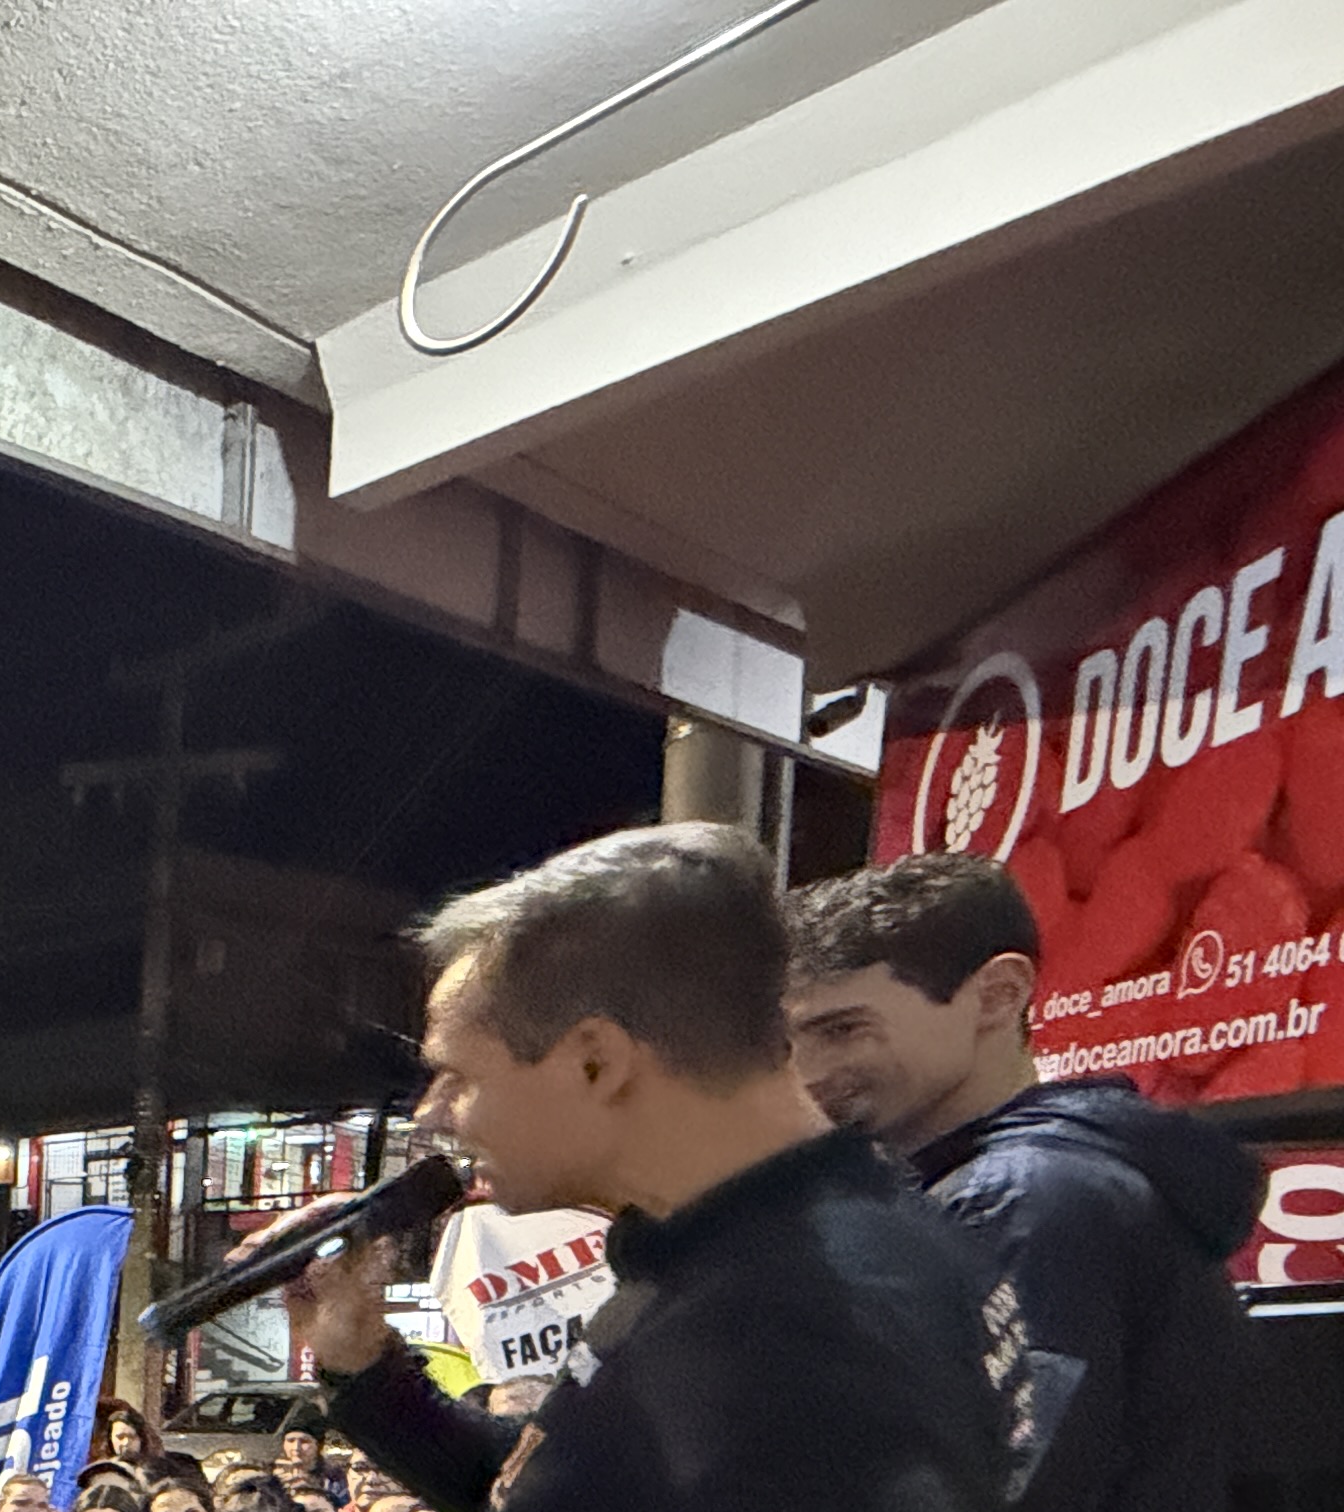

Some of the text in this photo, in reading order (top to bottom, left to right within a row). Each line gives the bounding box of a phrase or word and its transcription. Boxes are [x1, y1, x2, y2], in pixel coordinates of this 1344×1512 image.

[1058, 546, 1285, 814] DOCE
[1225, 951, 1256, 988] 51
[1262, 932, 1331, 978] 4064
[33, 1381, 72, 1498] ajeado
